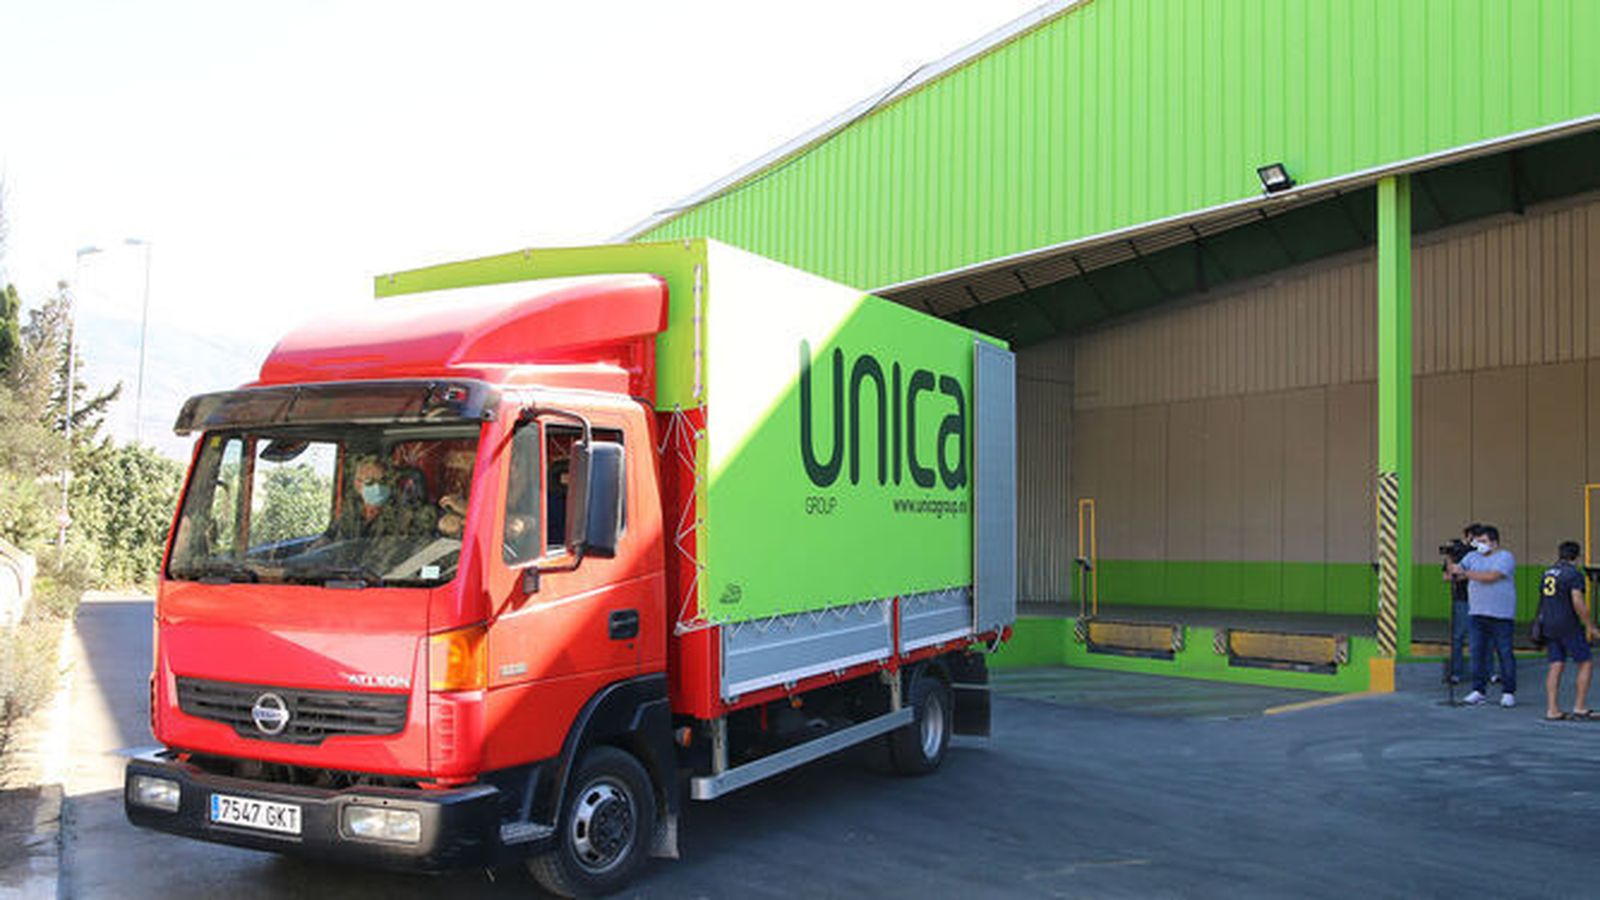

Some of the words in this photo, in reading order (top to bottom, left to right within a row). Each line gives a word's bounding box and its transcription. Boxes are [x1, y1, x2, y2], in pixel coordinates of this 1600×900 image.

[805, 496, 837, 515] GROUP
[1543, 575, 1556, 596] 3
[221, 798, 261, 824] 7547
[266, 805, 298, 830] GKT
